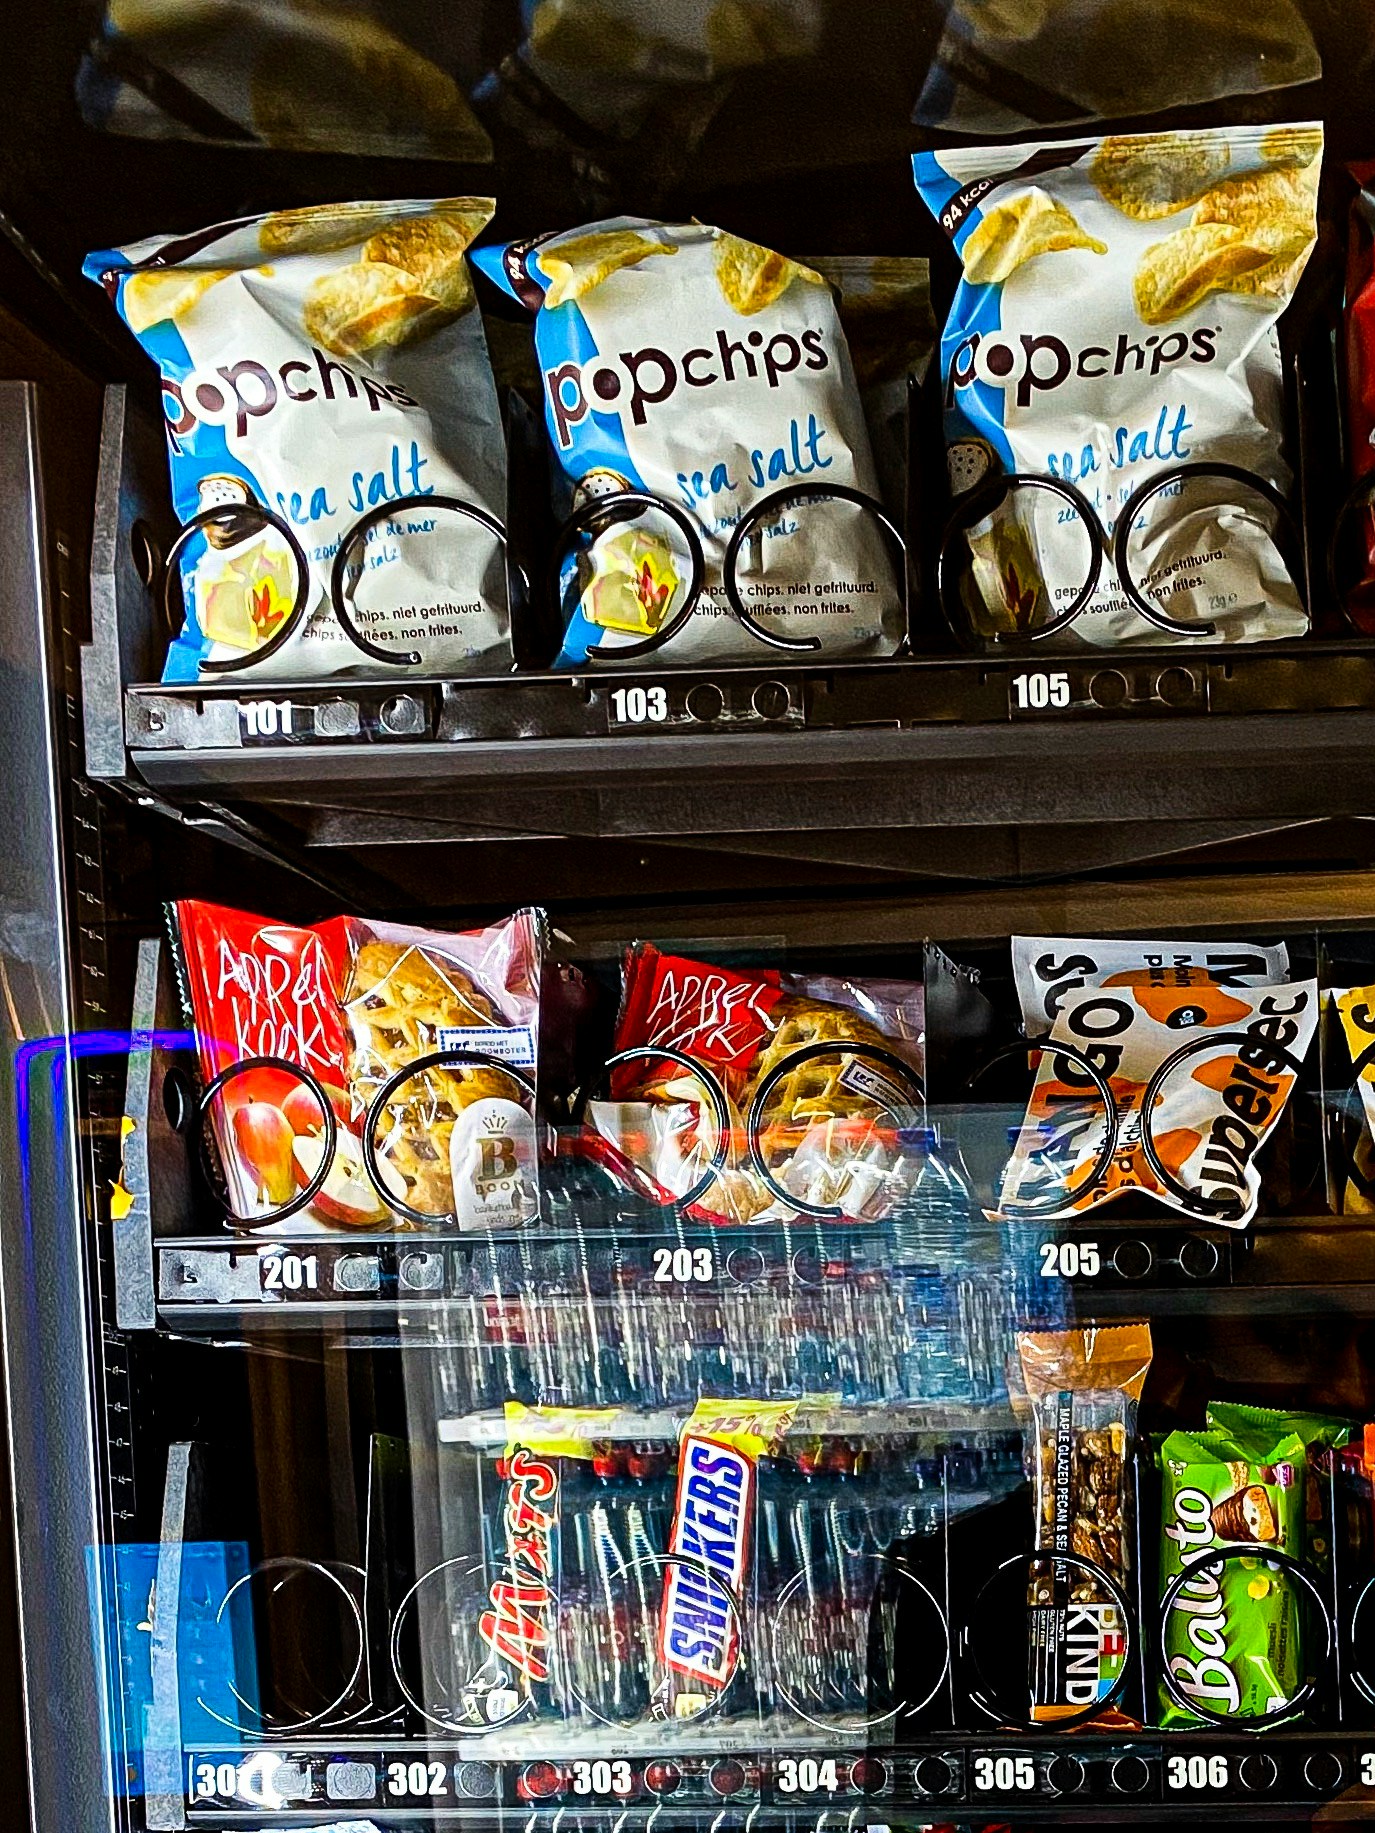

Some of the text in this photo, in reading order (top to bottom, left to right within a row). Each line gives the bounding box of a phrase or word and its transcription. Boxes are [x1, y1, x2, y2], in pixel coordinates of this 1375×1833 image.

[942, 203, 964, 231] 94
[944, 326, 1216, 410] popchips
[161, 346, 420, 457] popchips
[547, 327, 830, 449] popchips
[1047, 402, 1193, 484] sea salt
[348, 441, 434, 514] salt
[676, 413, 833, 509] sea salt
[788, 573, 811, 596] niet
[393, 600, 487, 626] niet gefrituurd.
[794, 599, 856, 617] non frites.
[428, 623, 464, 643] frites.
[611, 687, 667, 722] 103
[1013, 673, 1071, 708] 105
[246, 700, 292, 735] 101
[264, 1256, 317, 1289] 201
[654, 1248, 714, 1281] 203
[1040, 1243, 1100, 1277] 205
[1056, 1407, 1073, 1530] MAPLE GLAZED PECAN
[665, 1440, 748, 1680] SNICKERS
[1164, 1487, 1243, 1714] Balisto
[1065, 1602, 1101, 1705] KIND
[388, 1762, 449, 1797] 302
[573, 1762, 632, 1795] 303
[778, 1759, 839, 1792] 304
[974, 1757, 1035, 1790] 305
[1168, 1756, 1229, 1788] 306
